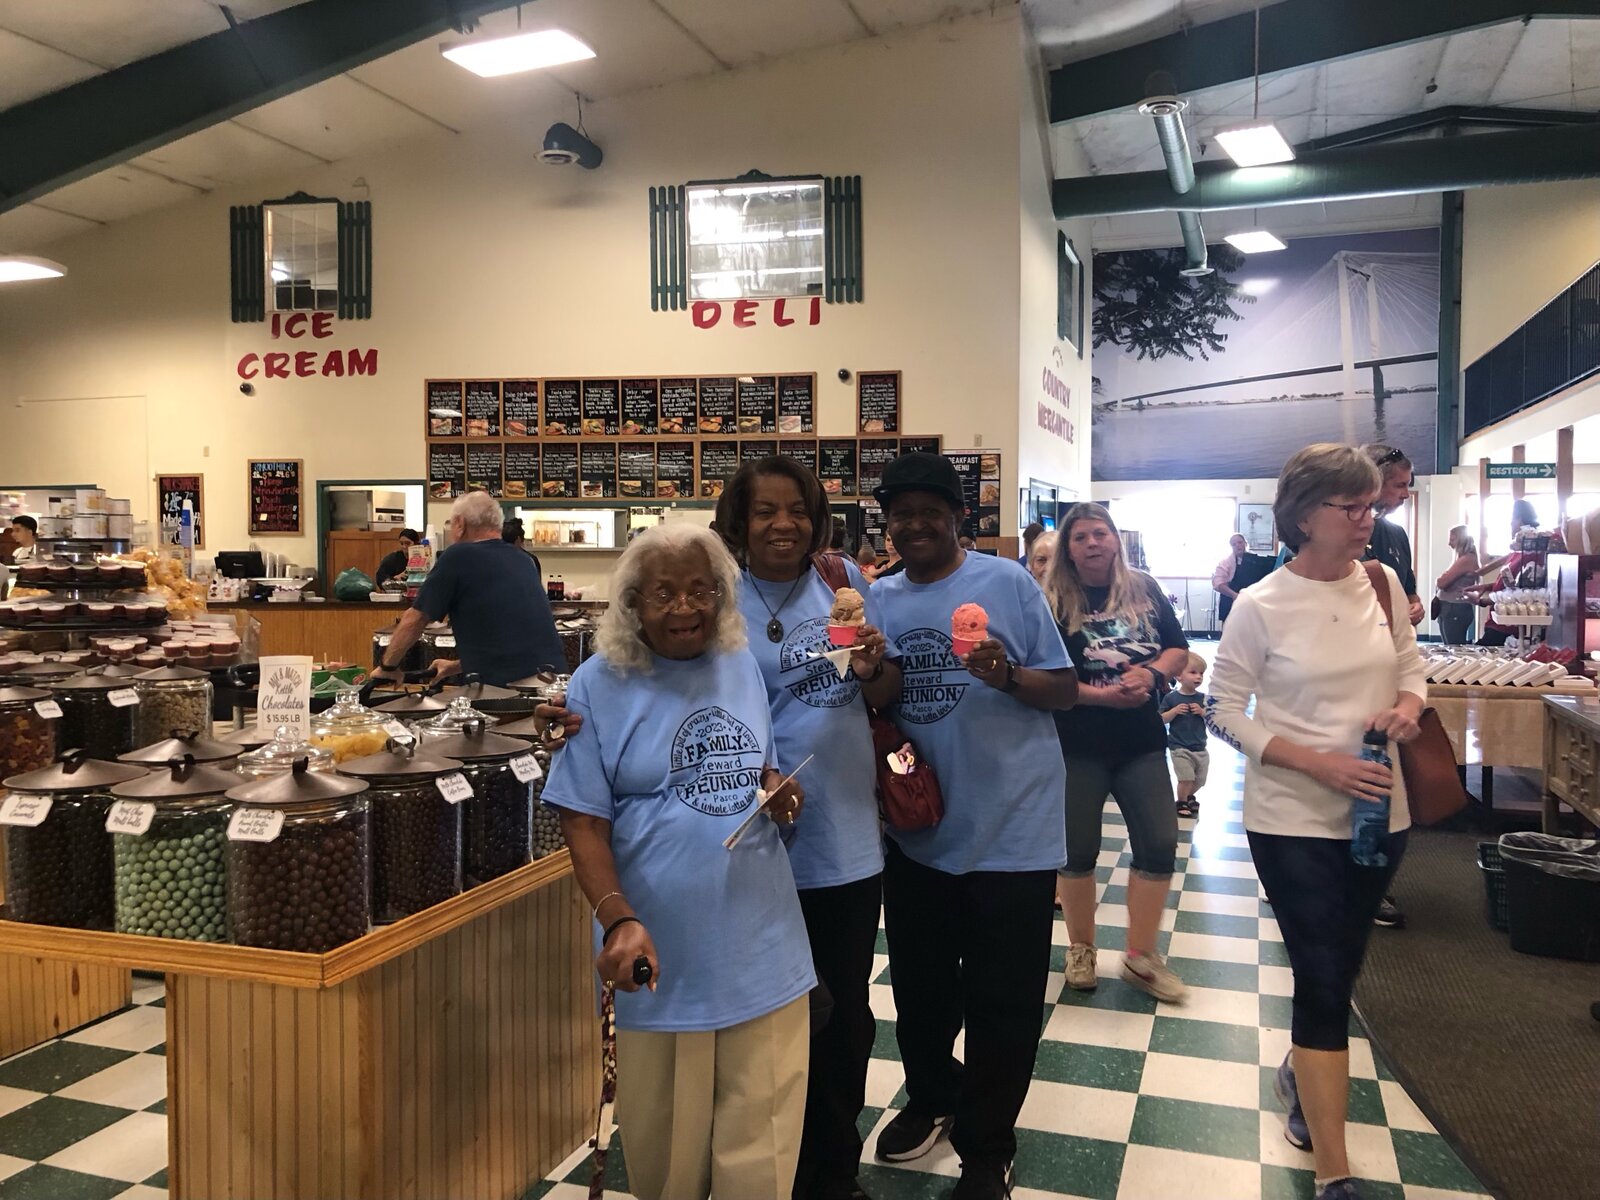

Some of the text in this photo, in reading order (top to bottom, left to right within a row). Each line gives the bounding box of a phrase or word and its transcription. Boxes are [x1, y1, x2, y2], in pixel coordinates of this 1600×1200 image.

[691, 297, 821, 329] DELI
[271, 312, 334, 339] ICE
[237, 348, 378, 380] CREAM
[1042, 366, 1070, 410] COUNTRY
[1037, 400, 1074, 445] MERCANTILE
[1490, 467, 1537, 475] RESTROOM
[910, 643, 932, 653] 2023
[903, 652, 949, 670] AMILY
[903, 672, 942, 686] teward
[275, 683, 294, 695] Kettle
[902, 687, 957, 704] EUNION
[262, 695, 304, 710] Chocolates
[912, 704, 933, 712] Pasco
[290, 714, 300, 722] LB
[700, 722, 723, 738] 2023
[685, 734, 743, 762] FAMILY
[696, 757, 742, 773] Steward
[685, 770, 759, 800] REUNION
[713, 793, 738, 803] Pasco
